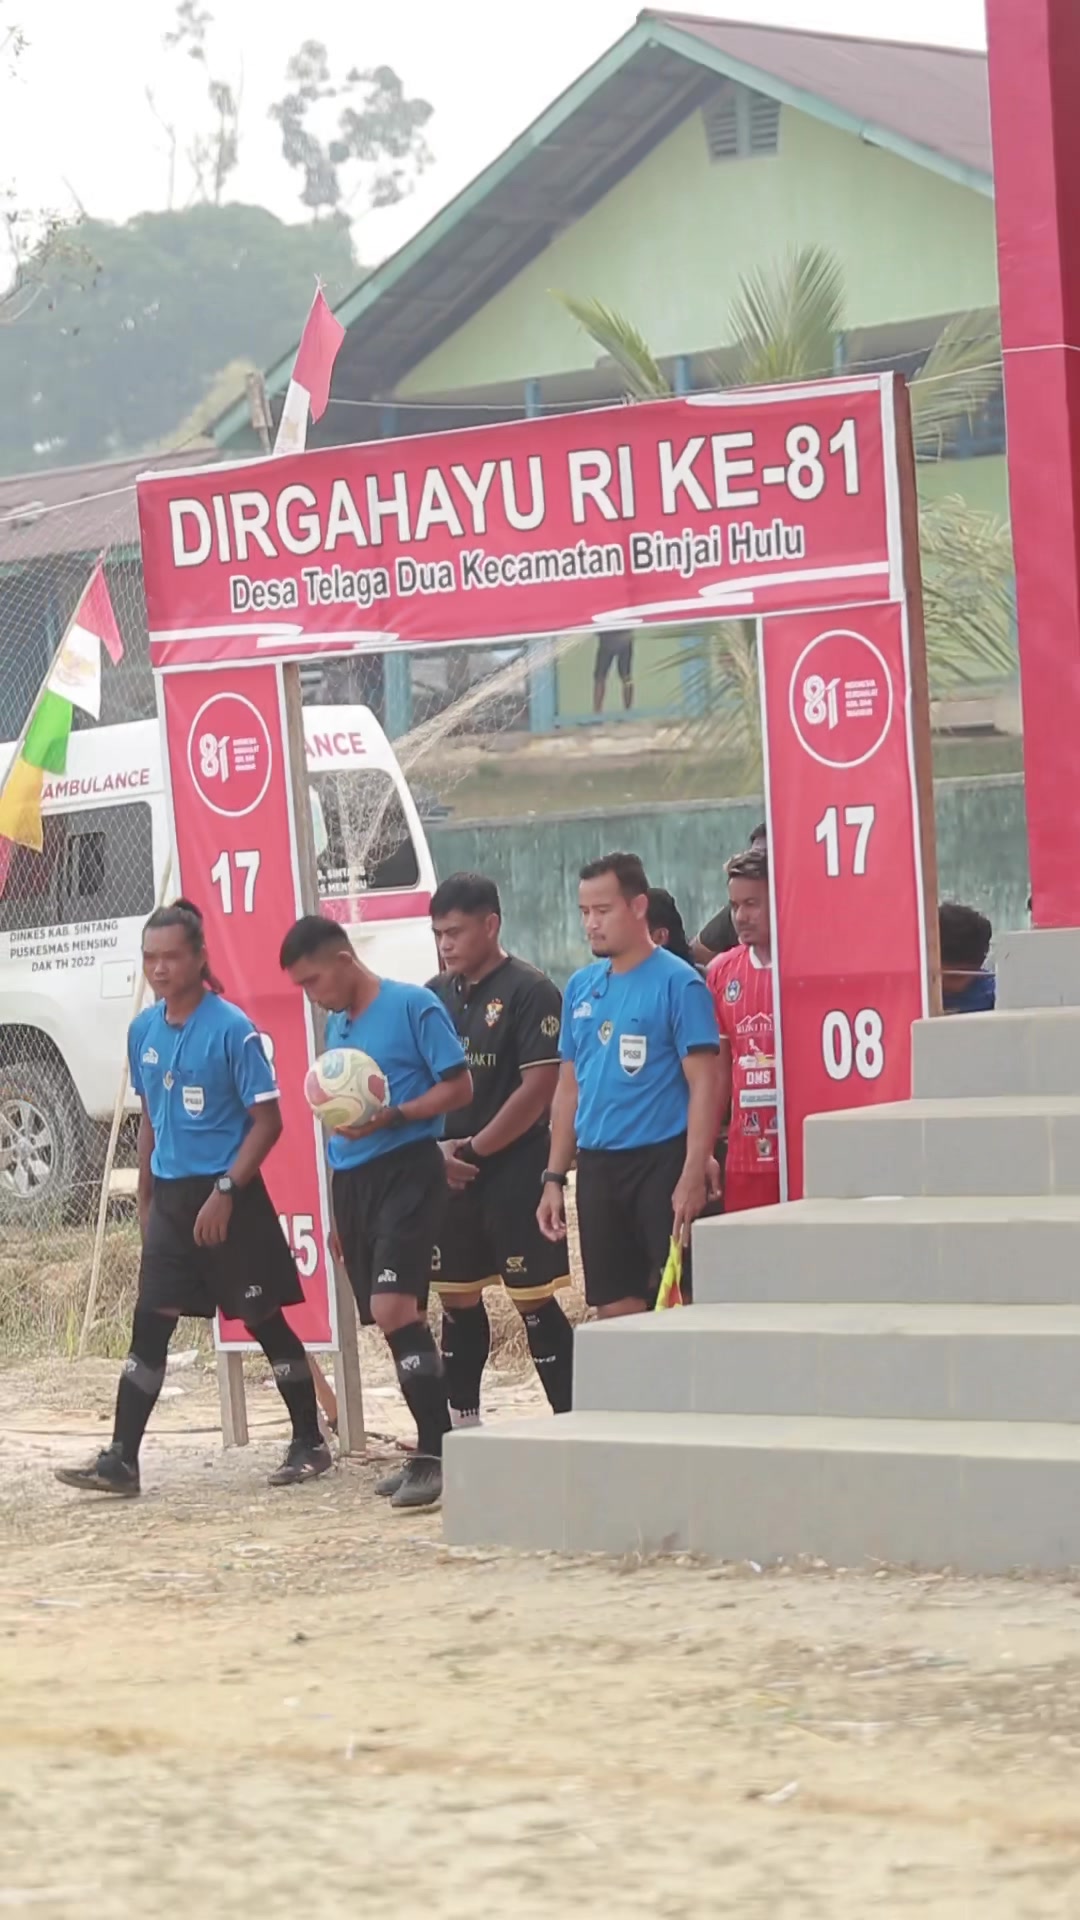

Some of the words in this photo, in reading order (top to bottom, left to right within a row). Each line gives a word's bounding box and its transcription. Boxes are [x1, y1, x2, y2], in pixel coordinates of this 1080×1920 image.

[168, 455, 546, 568] DIRGAHAYU
[567, 445, 636, 524] RI
[657, 417, 861, 515] KE-81
[231, 577, 297, 611] Desa
[303, 566, 389, 606] Telaga
[397, 560, 452, 592] Dua
[461, 543, 623, 588] Kecamatan
[631, 527, 720, 576] Binjai
[730, 521, 803, 560] Hulu
[803, 674, 841, 730] 81
[42, 768, 150, 799] AMBULANCE
[814, 804, 876, 878] 17
[210, 850, 261, 914] 17
[10, 928, 46, 942] DINKES
[74, 920, 119, 936] SINTANG
[10, 942, 70, 959] PUSKESMAS
[72, 937, 118, 952] MENSIKU
[32, 961, 52, 972] DAK
[56, 958, 68, 970] TH
[71, 956, 96, 969] 2022
[821, 1007, 885, 1082] 08
